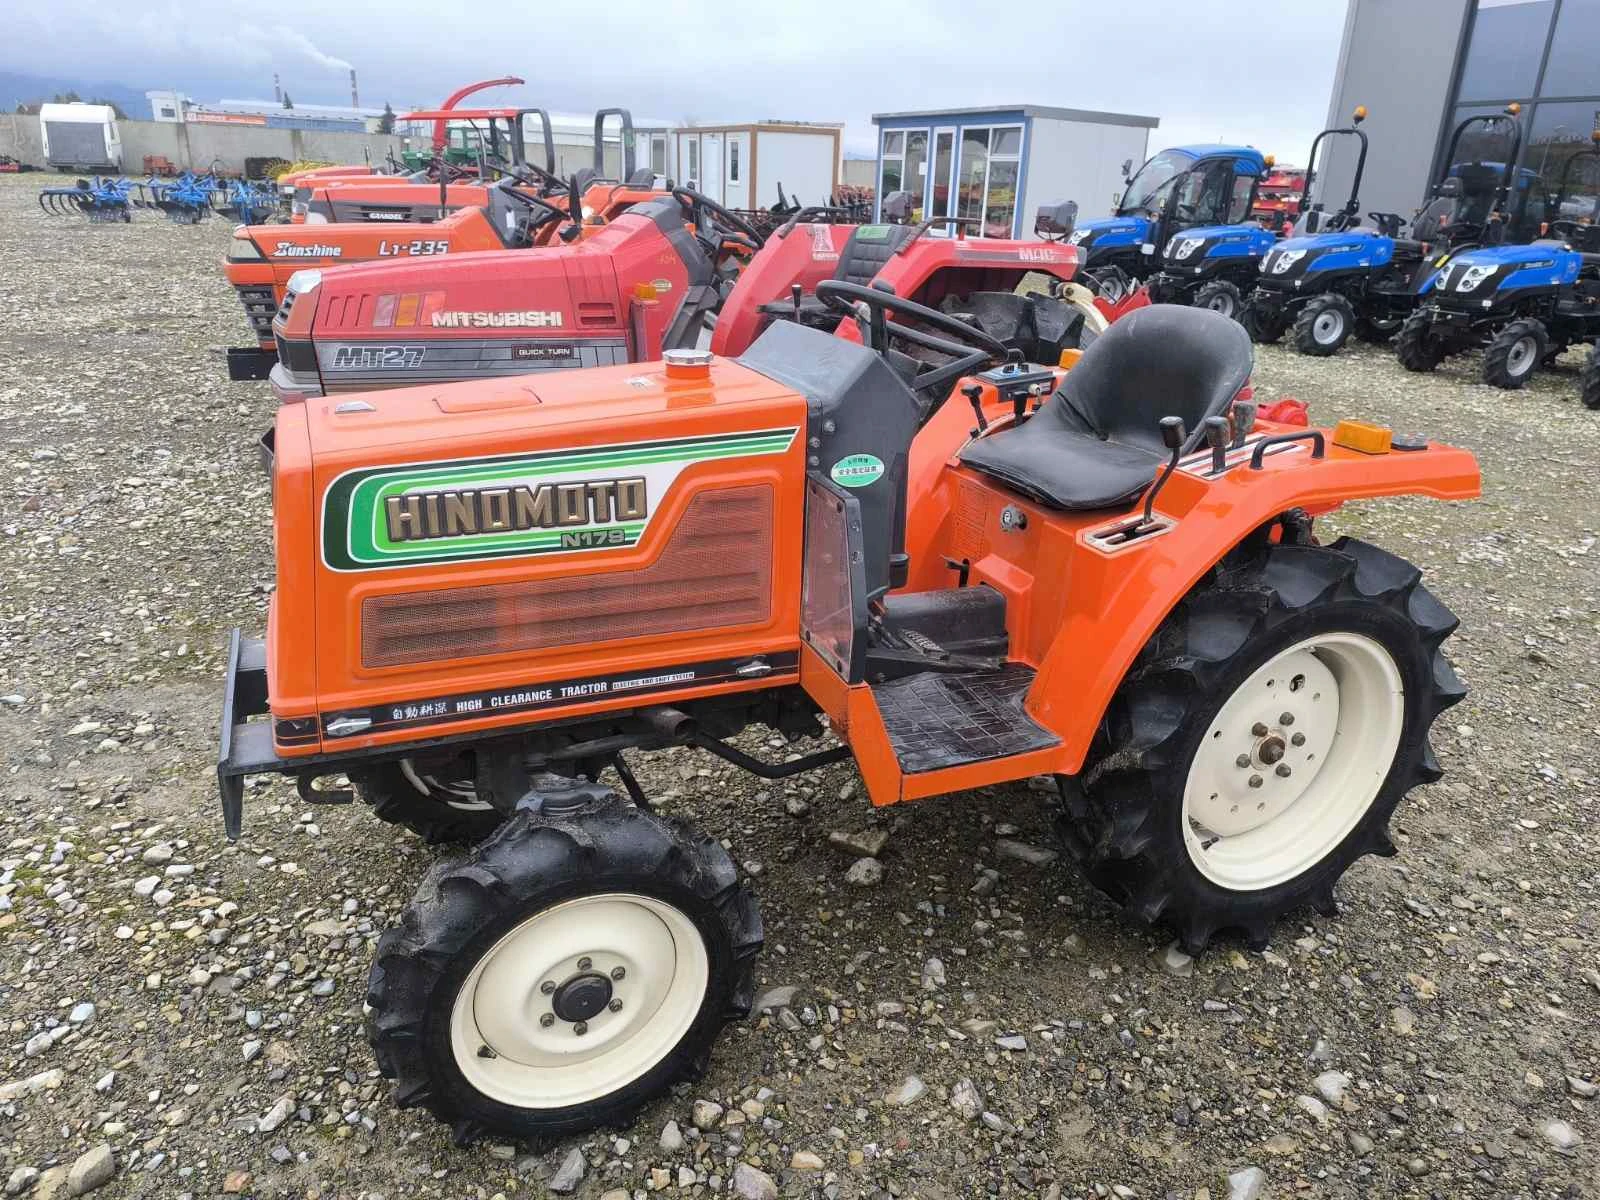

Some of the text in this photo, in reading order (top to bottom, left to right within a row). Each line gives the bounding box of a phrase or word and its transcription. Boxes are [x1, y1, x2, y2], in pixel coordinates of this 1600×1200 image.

[272, 241, 342, 257] Sunshine
[431, 311, 562, 328] MITSUBISHI
[331, 346, 427, 369] MT27
[518, 348, 572, 356] QUICK TURN
[385, 476, 648, 543] HINOMOTO
[456, 681, 608, 712] HIGH CLEARANCE TRACTOR
